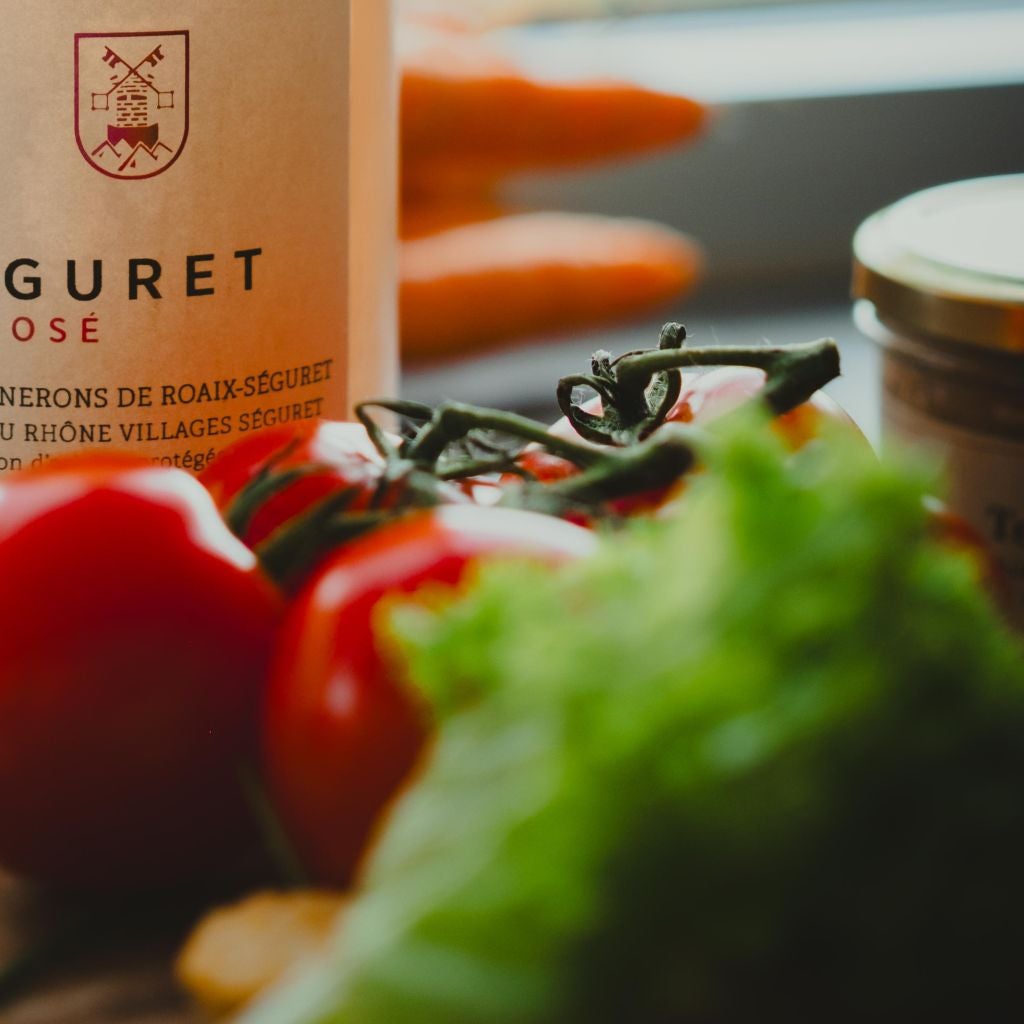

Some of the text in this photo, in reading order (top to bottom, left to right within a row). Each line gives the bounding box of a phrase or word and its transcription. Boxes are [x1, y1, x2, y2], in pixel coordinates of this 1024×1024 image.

[117, 387, 153, 408] DE
[161, 359, 333, 406] ROAIX-SÉGURET
[24, 421, 112, 443] RHÔNE
[120, 416, 232, 442] VILLAGES
[239, 397, 324, 432] SÉGURET
